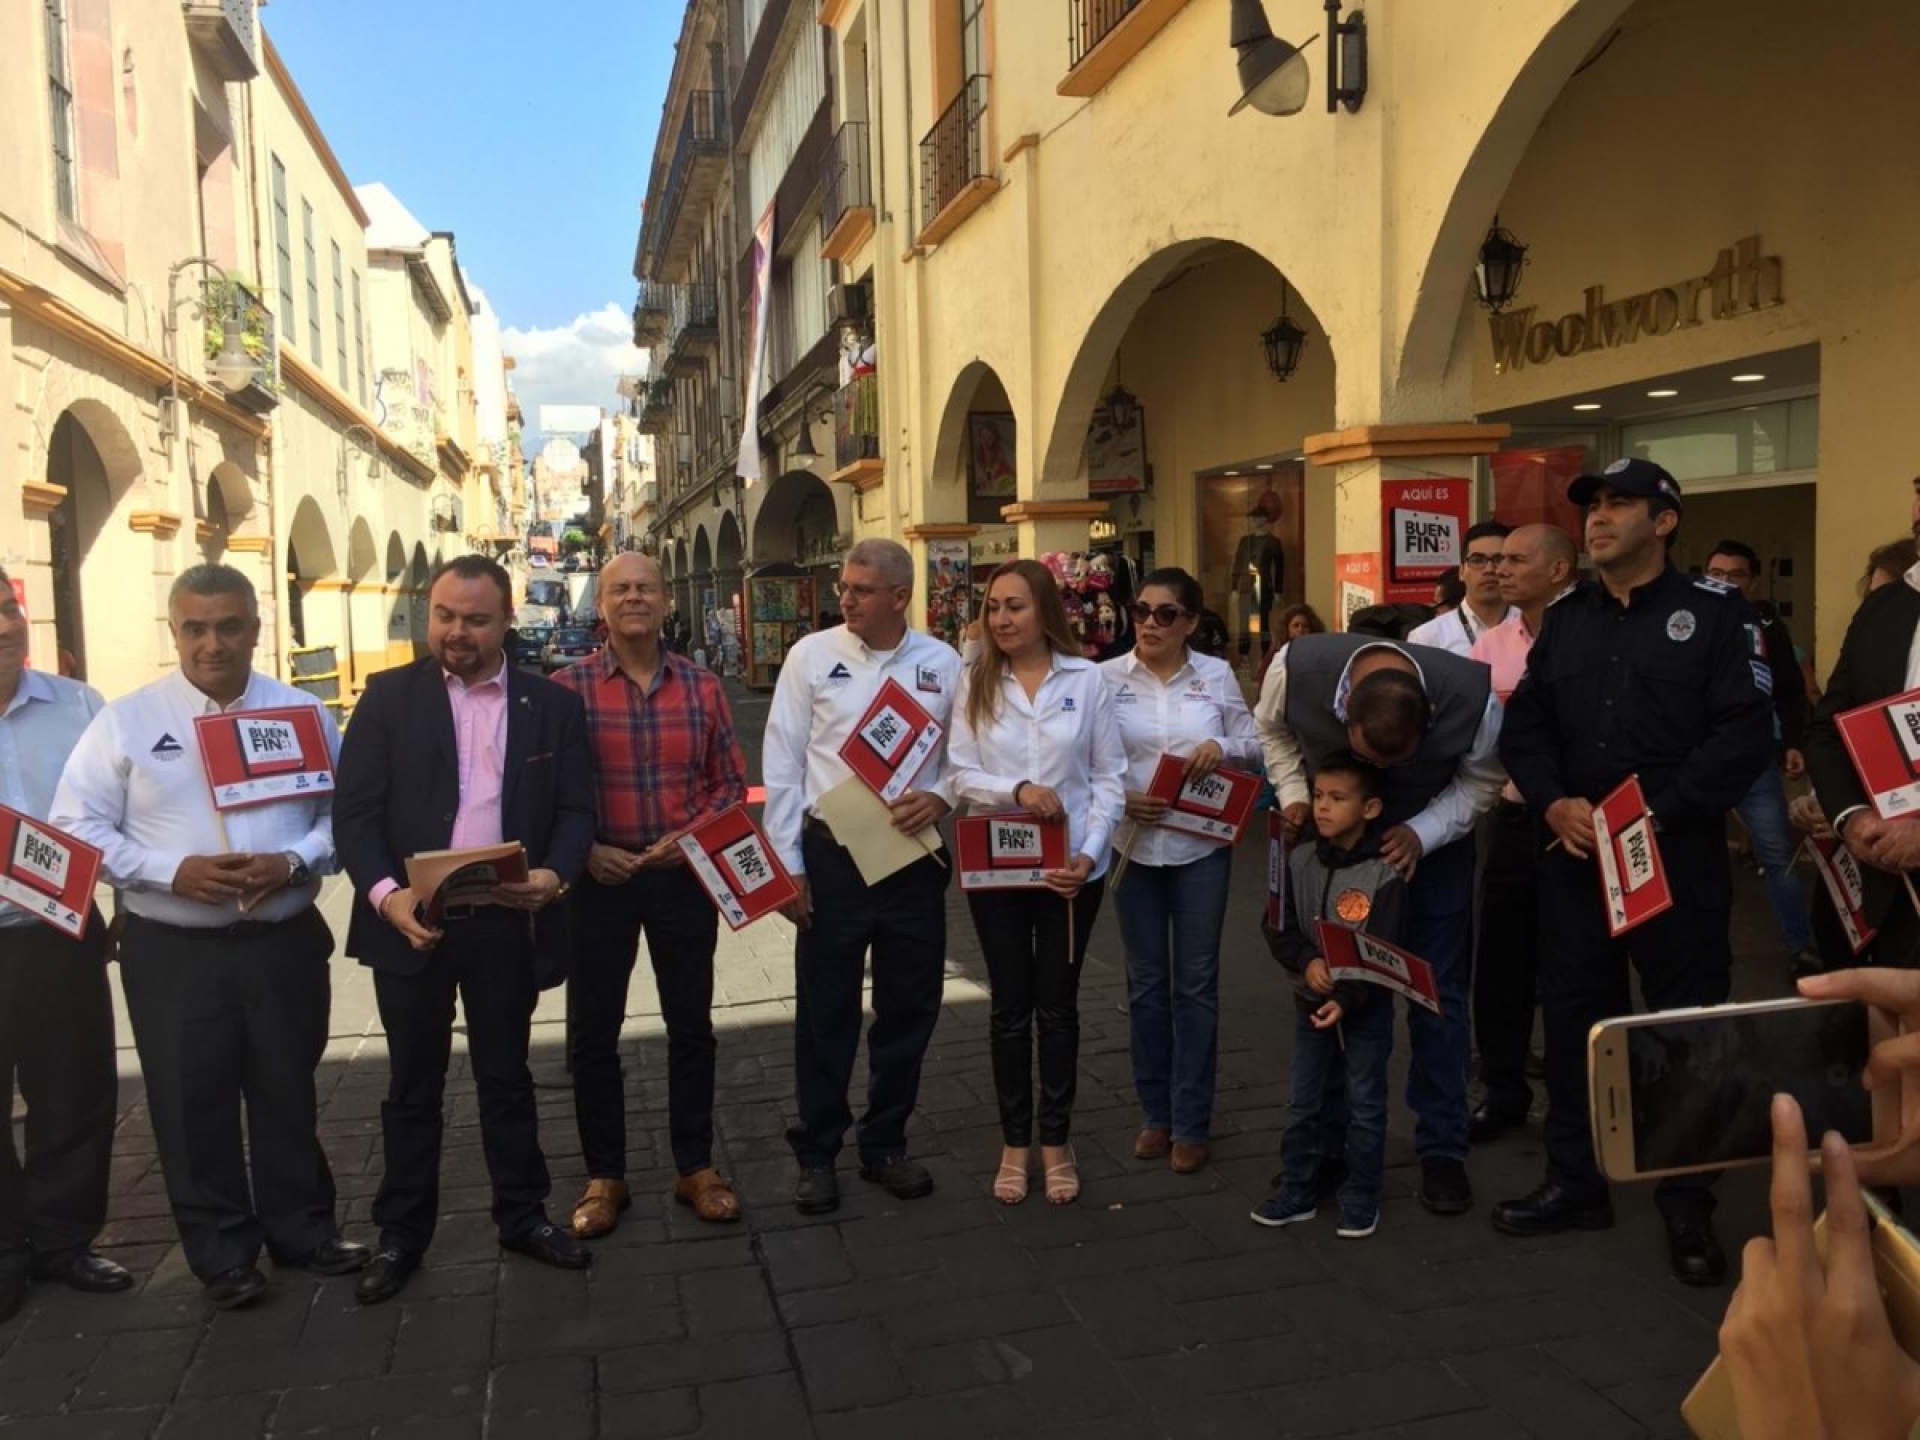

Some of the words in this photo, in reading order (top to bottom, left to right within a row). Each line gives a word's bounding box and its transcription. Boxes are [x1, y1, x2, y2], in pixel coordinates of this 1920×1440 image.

[1488, 233, 1784, 374] Woolworth
[1436, 488, 1449, 500] ES
[1405, 520, 1450, 537] BUEN
[248, 727, 289, 739] BUEN
[998, 827, 1034, 839] BUEN
[27, 833, 62, 863] BUEN
